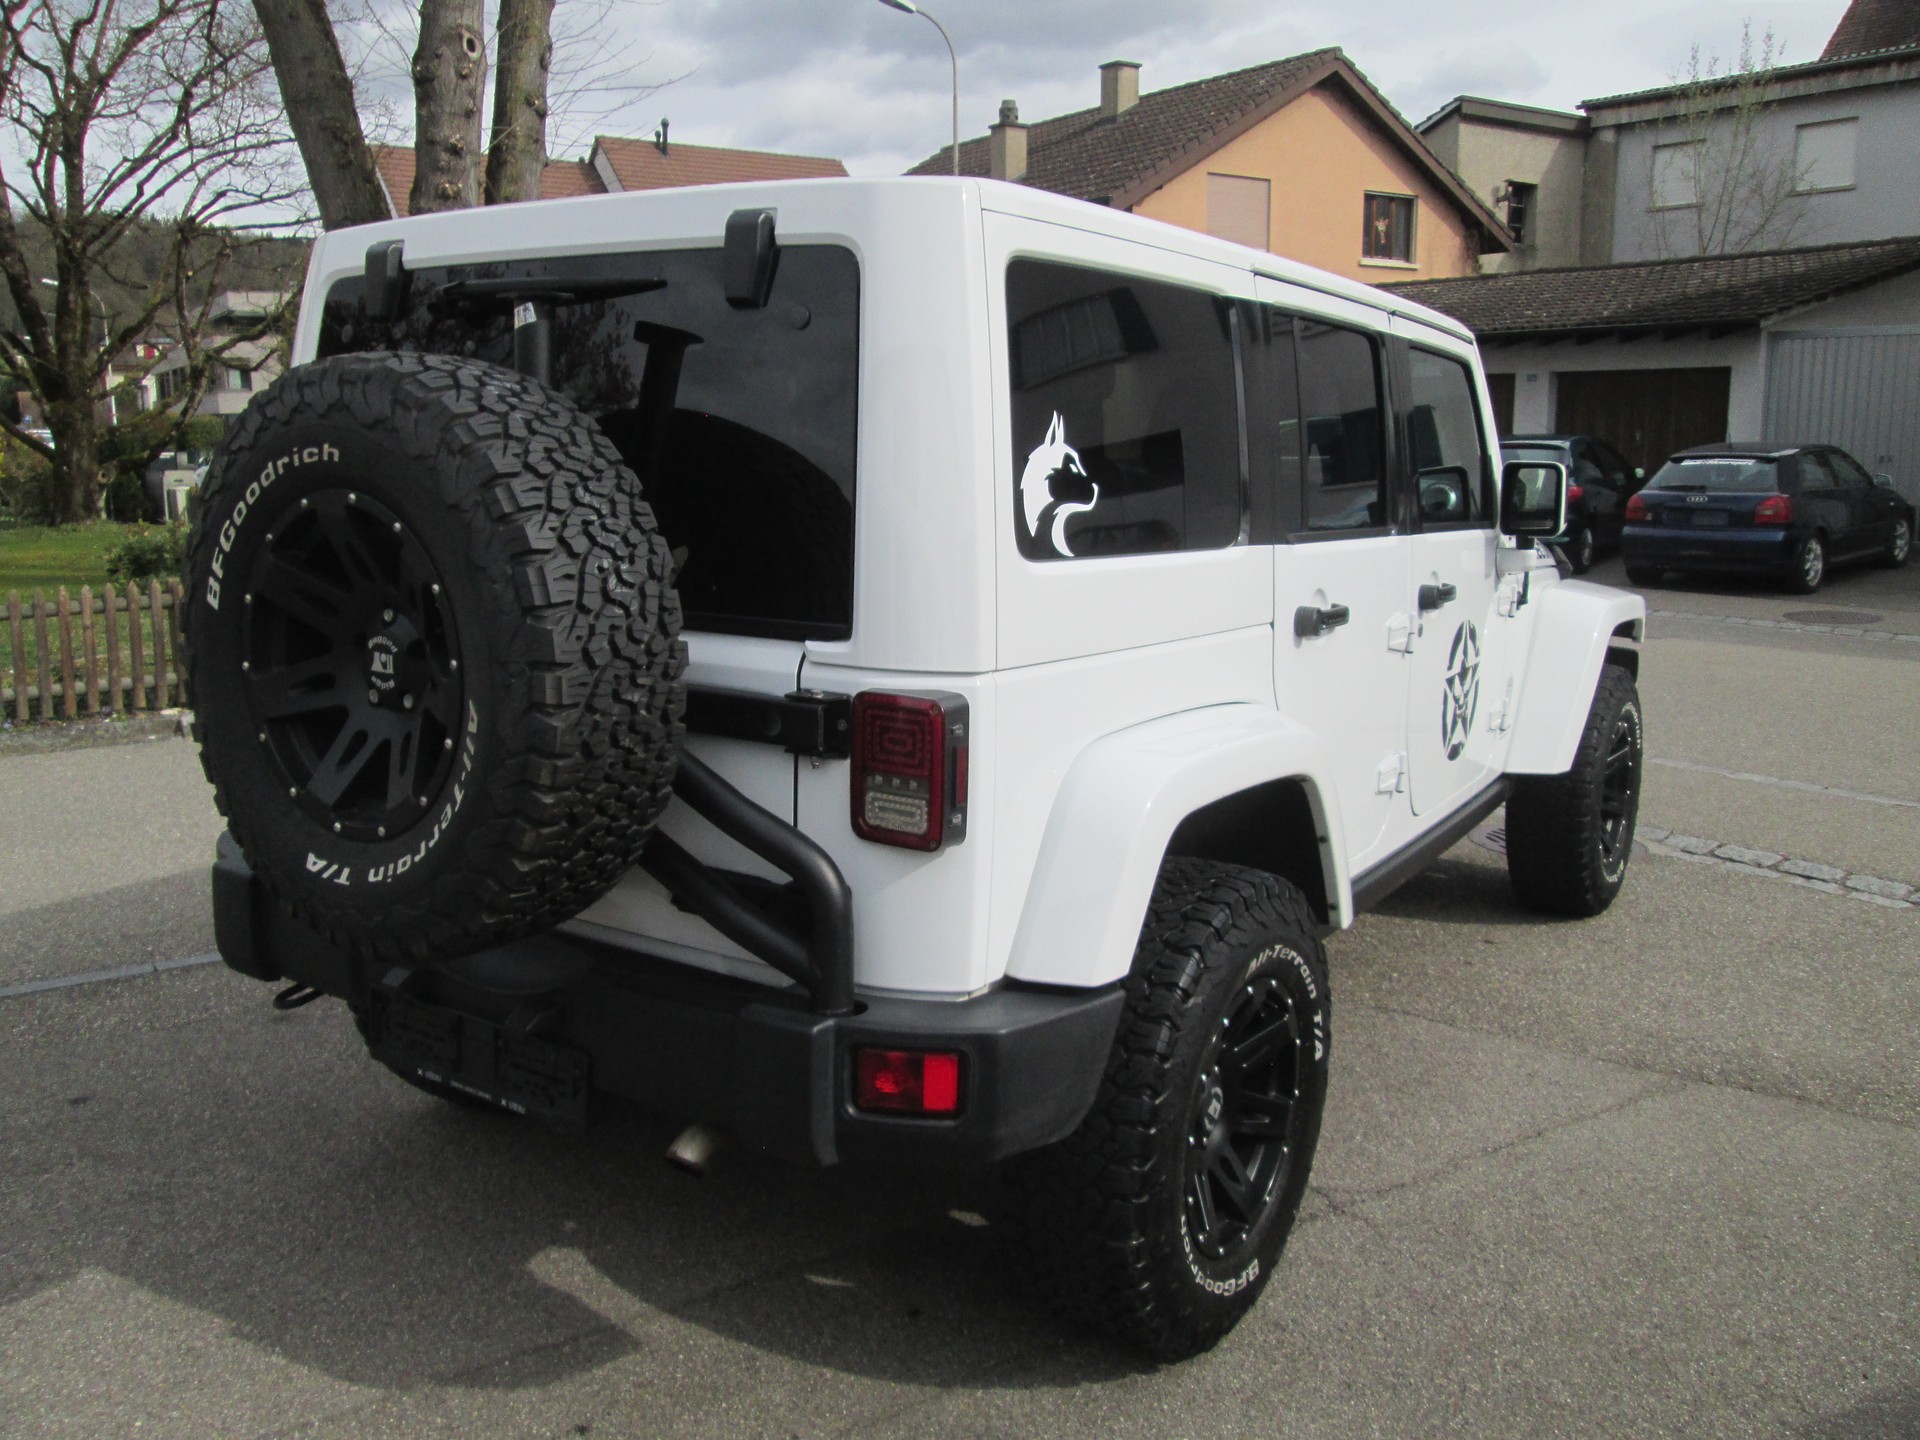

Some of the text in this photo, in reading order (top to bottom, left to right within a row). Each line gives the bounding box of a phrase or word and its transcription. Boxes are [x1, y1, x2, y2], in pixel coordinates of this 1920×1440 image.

[206, 443, 340, 611] BFGoodrich
[305, 699, 478, 886] All-Terrain T/A
[1244, 944, 1324, 1061] All-Terrain T/A
